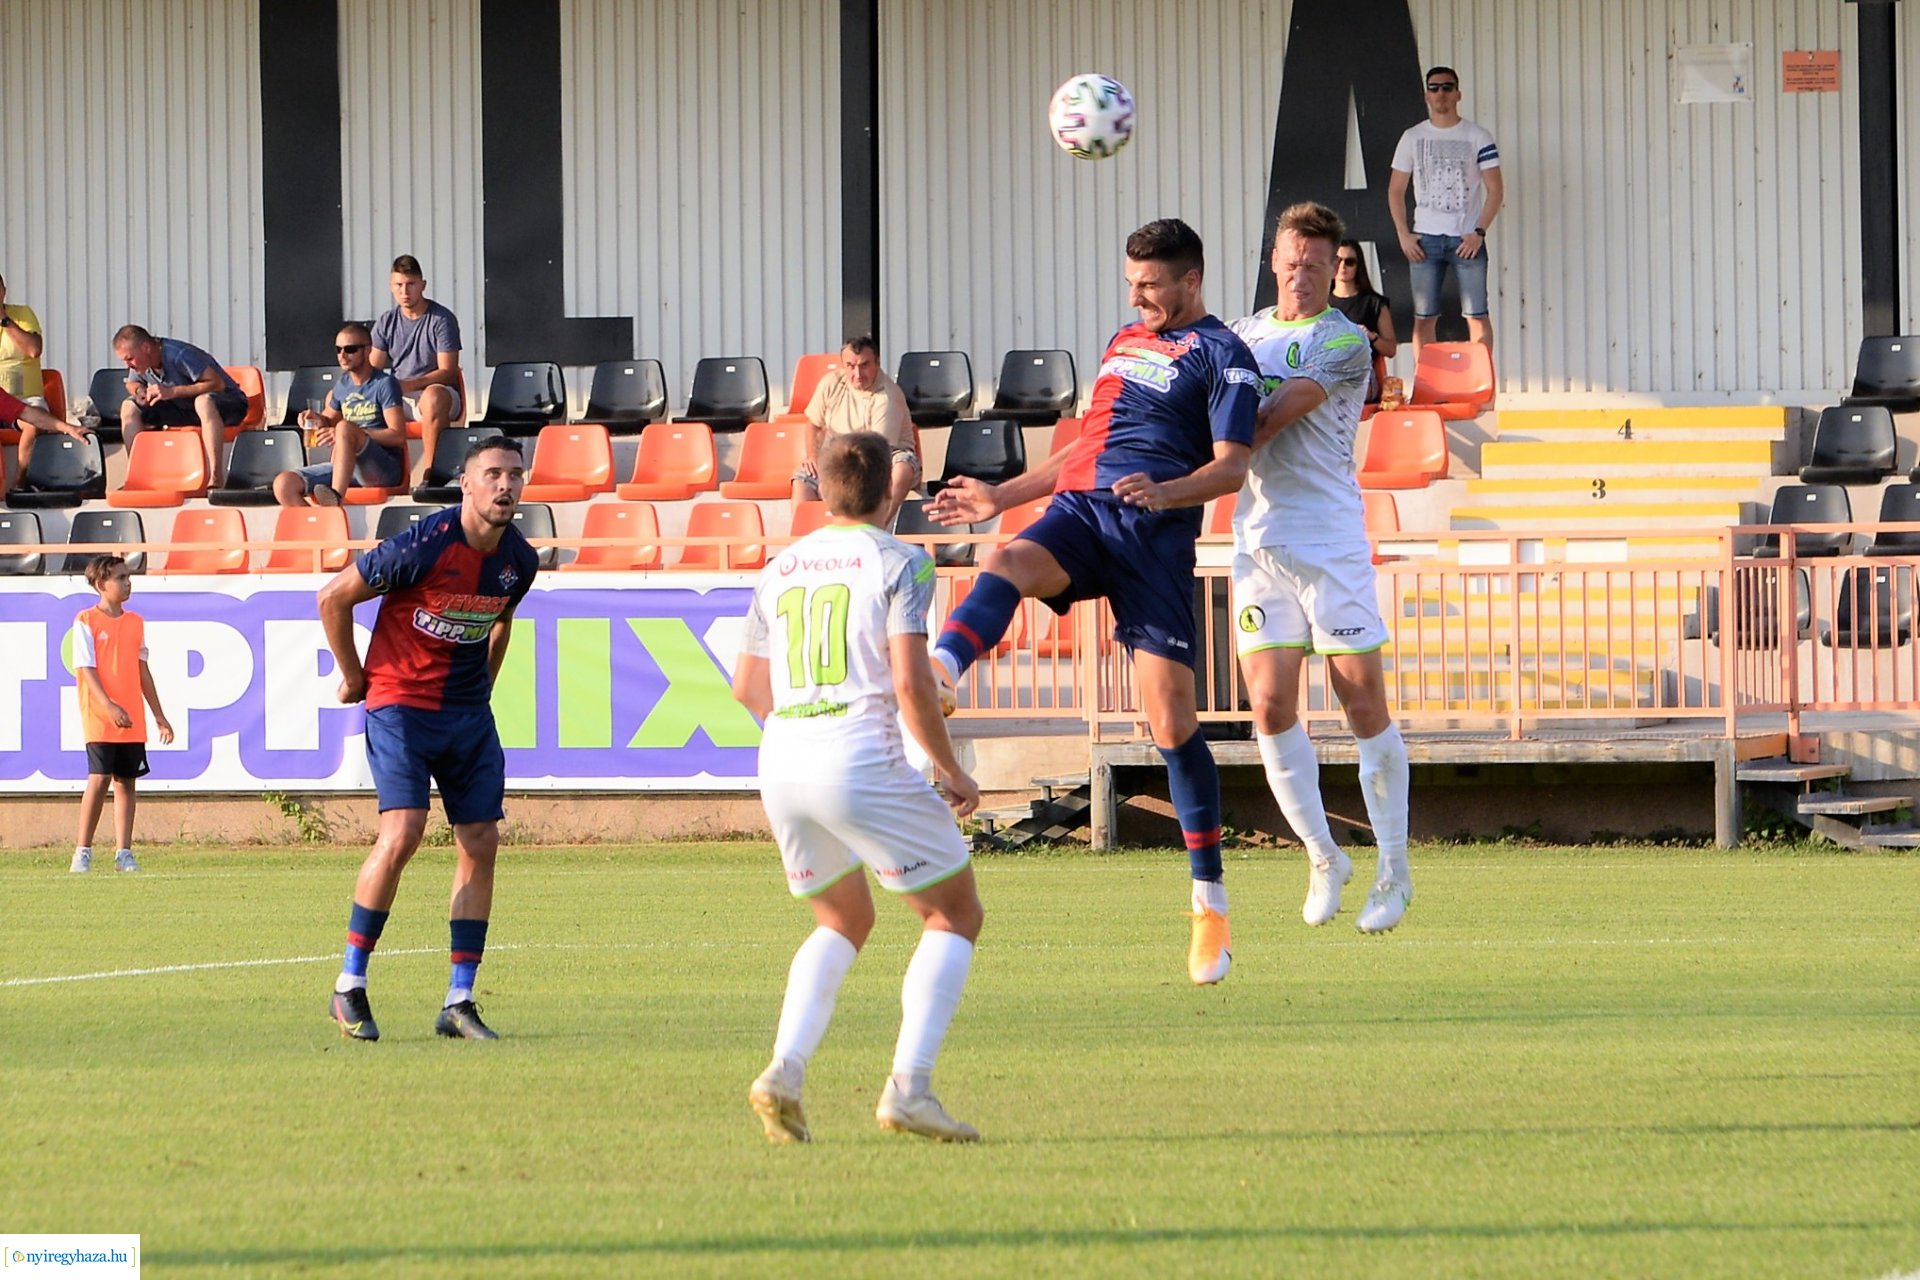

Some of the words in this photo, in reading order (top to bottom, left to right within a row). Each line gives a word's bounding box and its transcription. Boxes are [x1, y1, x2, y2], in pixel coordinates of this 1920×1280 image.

[1617, 418, 1635, 440] 4
[1592, 478, 1606, 499] 3
[802, 557, 862, 571] VEOLIA
[417, 611, 494, 640] TiPPMI
[777, 583, 850, 689] 10
[0, 617, 764, 751] PPIX
